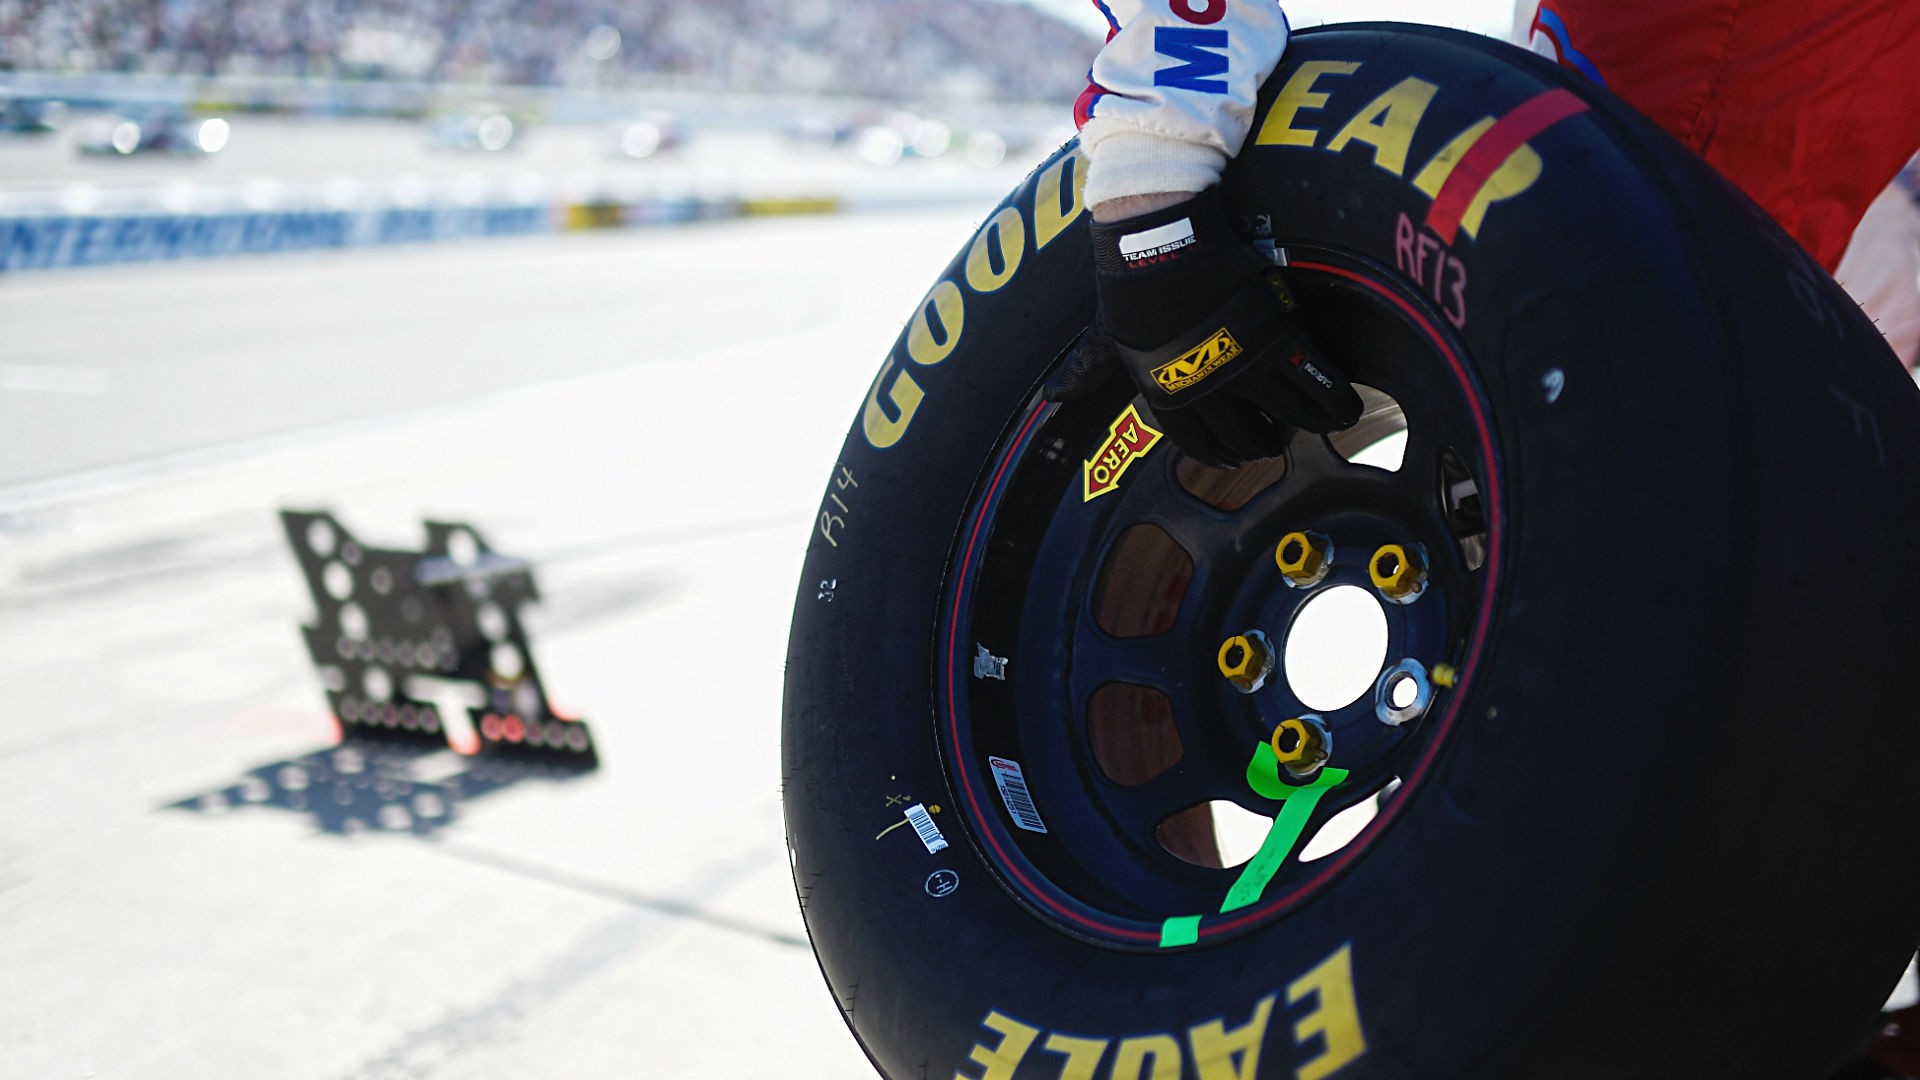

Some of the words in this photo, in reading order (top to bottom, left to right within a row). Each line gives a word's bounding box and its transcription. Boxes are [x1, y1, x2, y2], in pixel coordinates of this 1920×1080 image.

[1254, 60, 1543, 241] EAR
[1122, 248, 1158, 261] TEAM
[1158, 236, 1197, 254] ISSUE
[1396, 211, 1466, 329] RF13
[1094, 422, 1139, 484] AERO
[820, 466, 858, 547] R14
